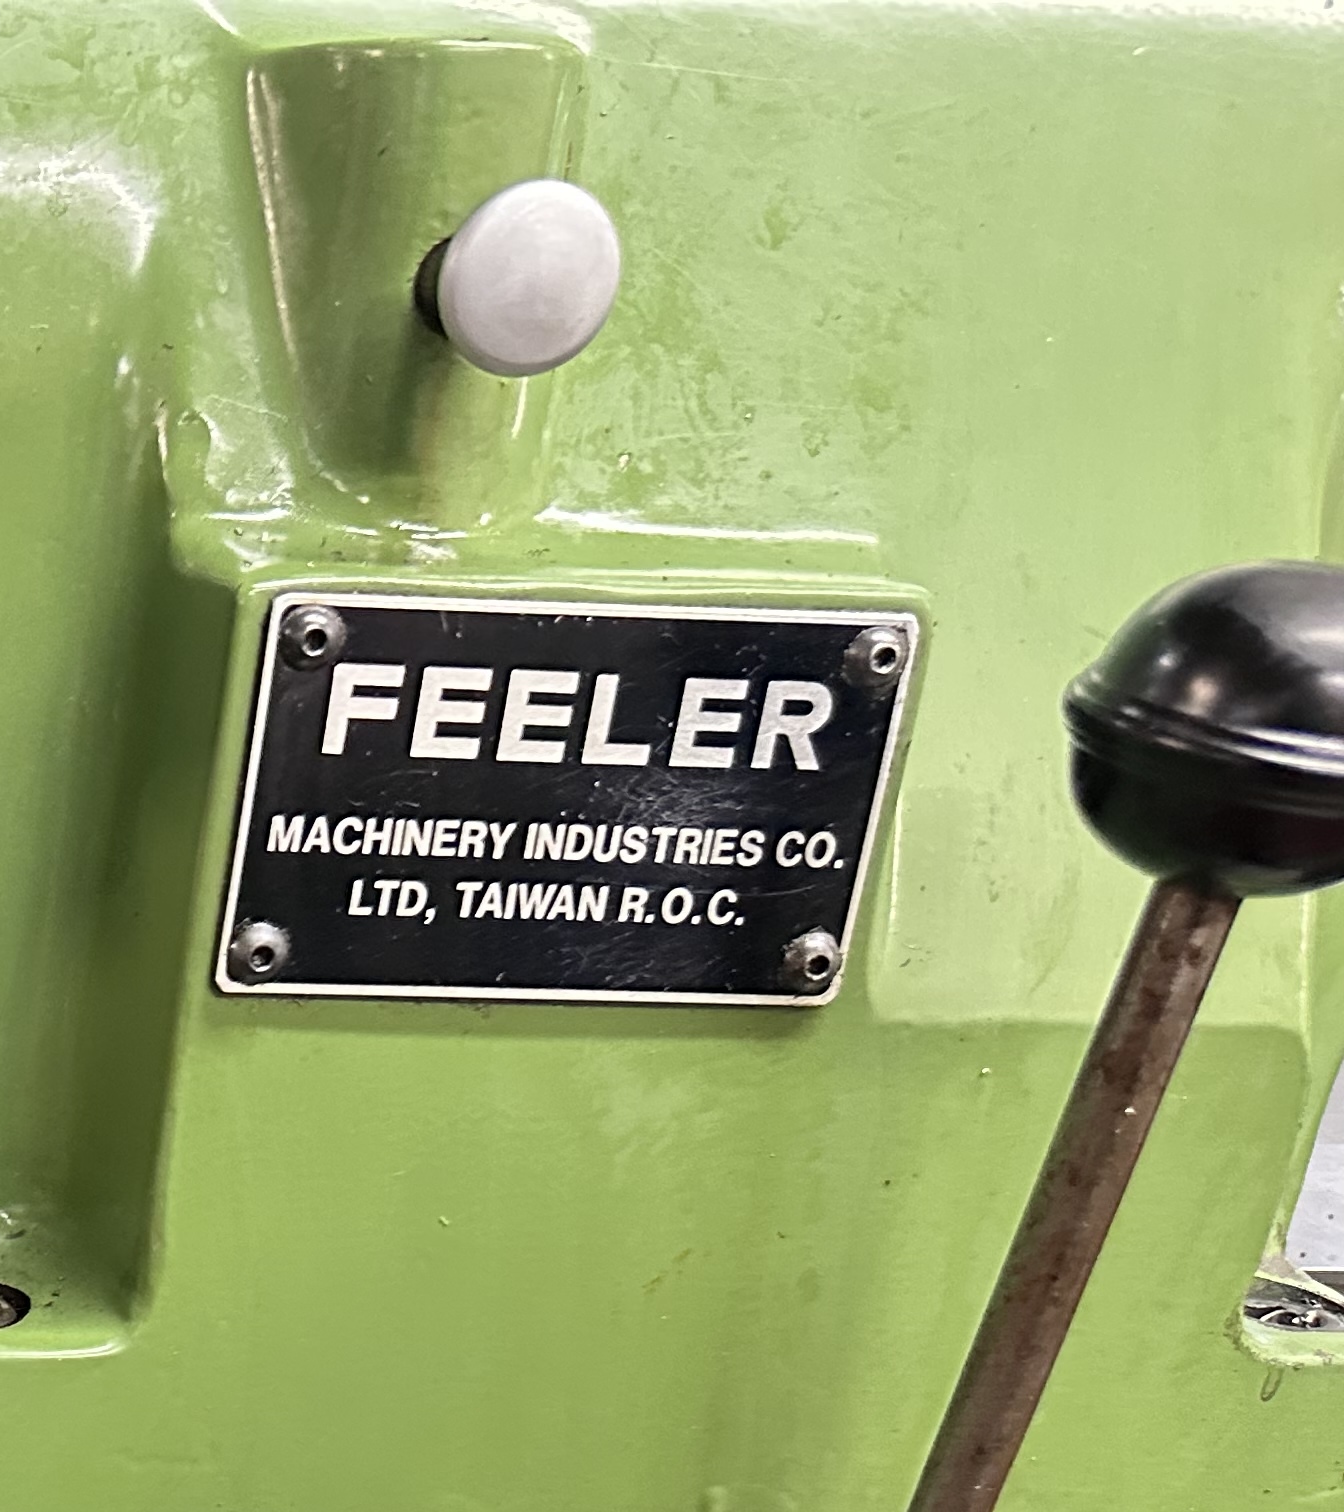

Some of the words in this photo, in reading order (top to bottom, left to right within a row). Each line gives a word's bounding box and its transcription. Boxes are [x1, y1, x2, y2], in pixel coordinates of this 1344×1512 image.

[321, 663, 833, 771] FEELER
[267, 815, 516, 860] MACHINERY
[523, 823, 765, 867] INDUSTRIES
[776, 831, 845, 869] CO.
[347, 879, 437, 926] LTD,
[455, 882, 609, 922] TAIWAN
[617, 887, 745, 926] R.O.C.
